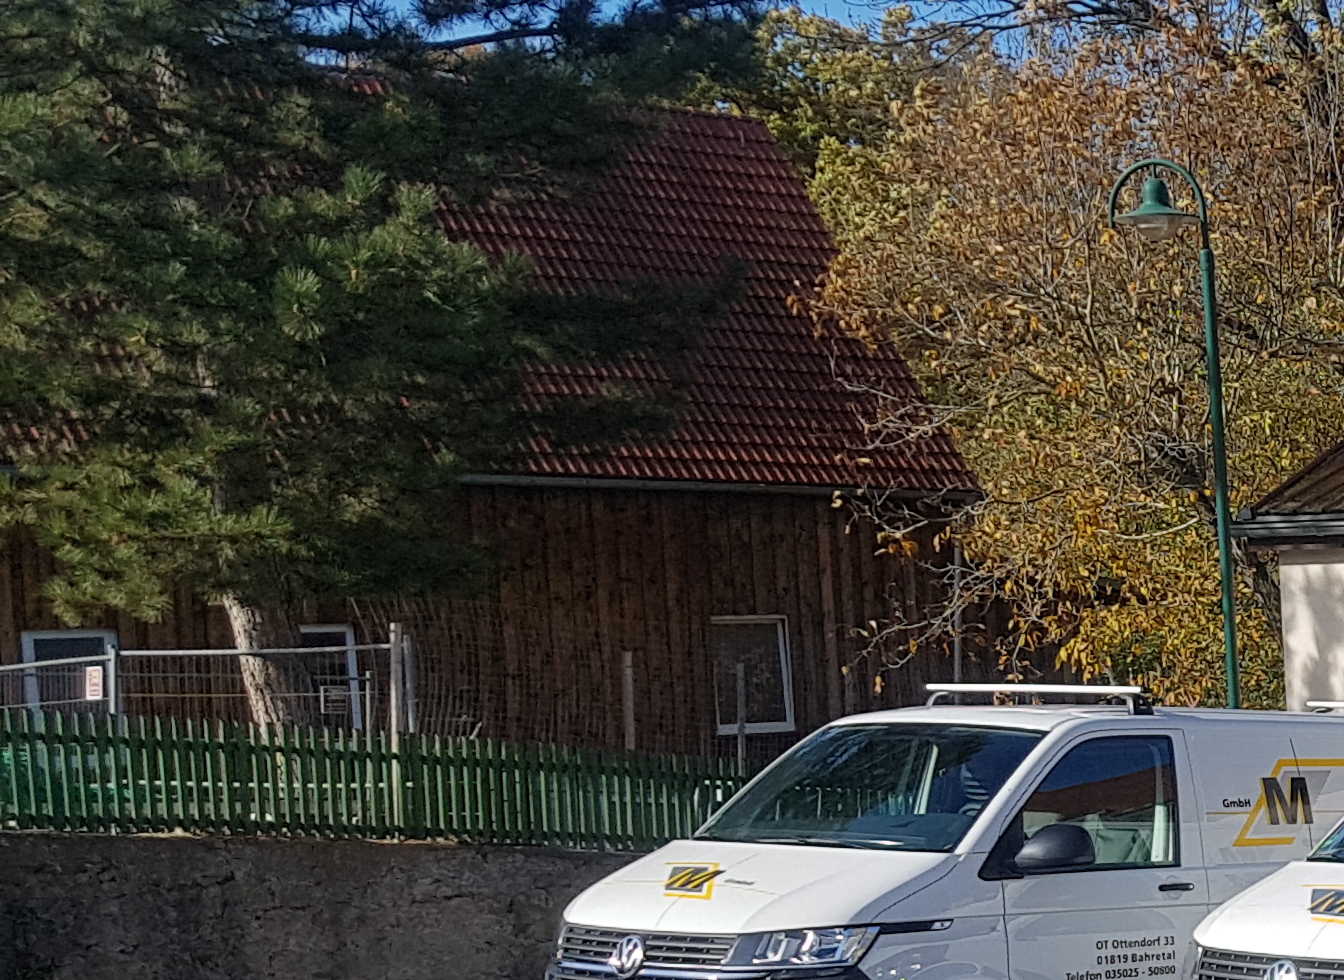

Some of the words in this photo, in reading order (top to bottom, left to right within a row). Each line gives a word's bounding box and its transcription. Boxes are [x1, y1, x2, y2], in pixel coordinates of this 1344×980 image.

[1222, 798, 1251, 808] GmbH
[1096, 939, 1109, 950] OT
[1112, 936, 1161, 949] Ottendorf
[1164, 936, 1175, 946] 33
[1097, 953, 1128, 965] 01819
[1131, 949, 1175, 962] Bahretal
[1105, 967, 1139, 979] 035025
